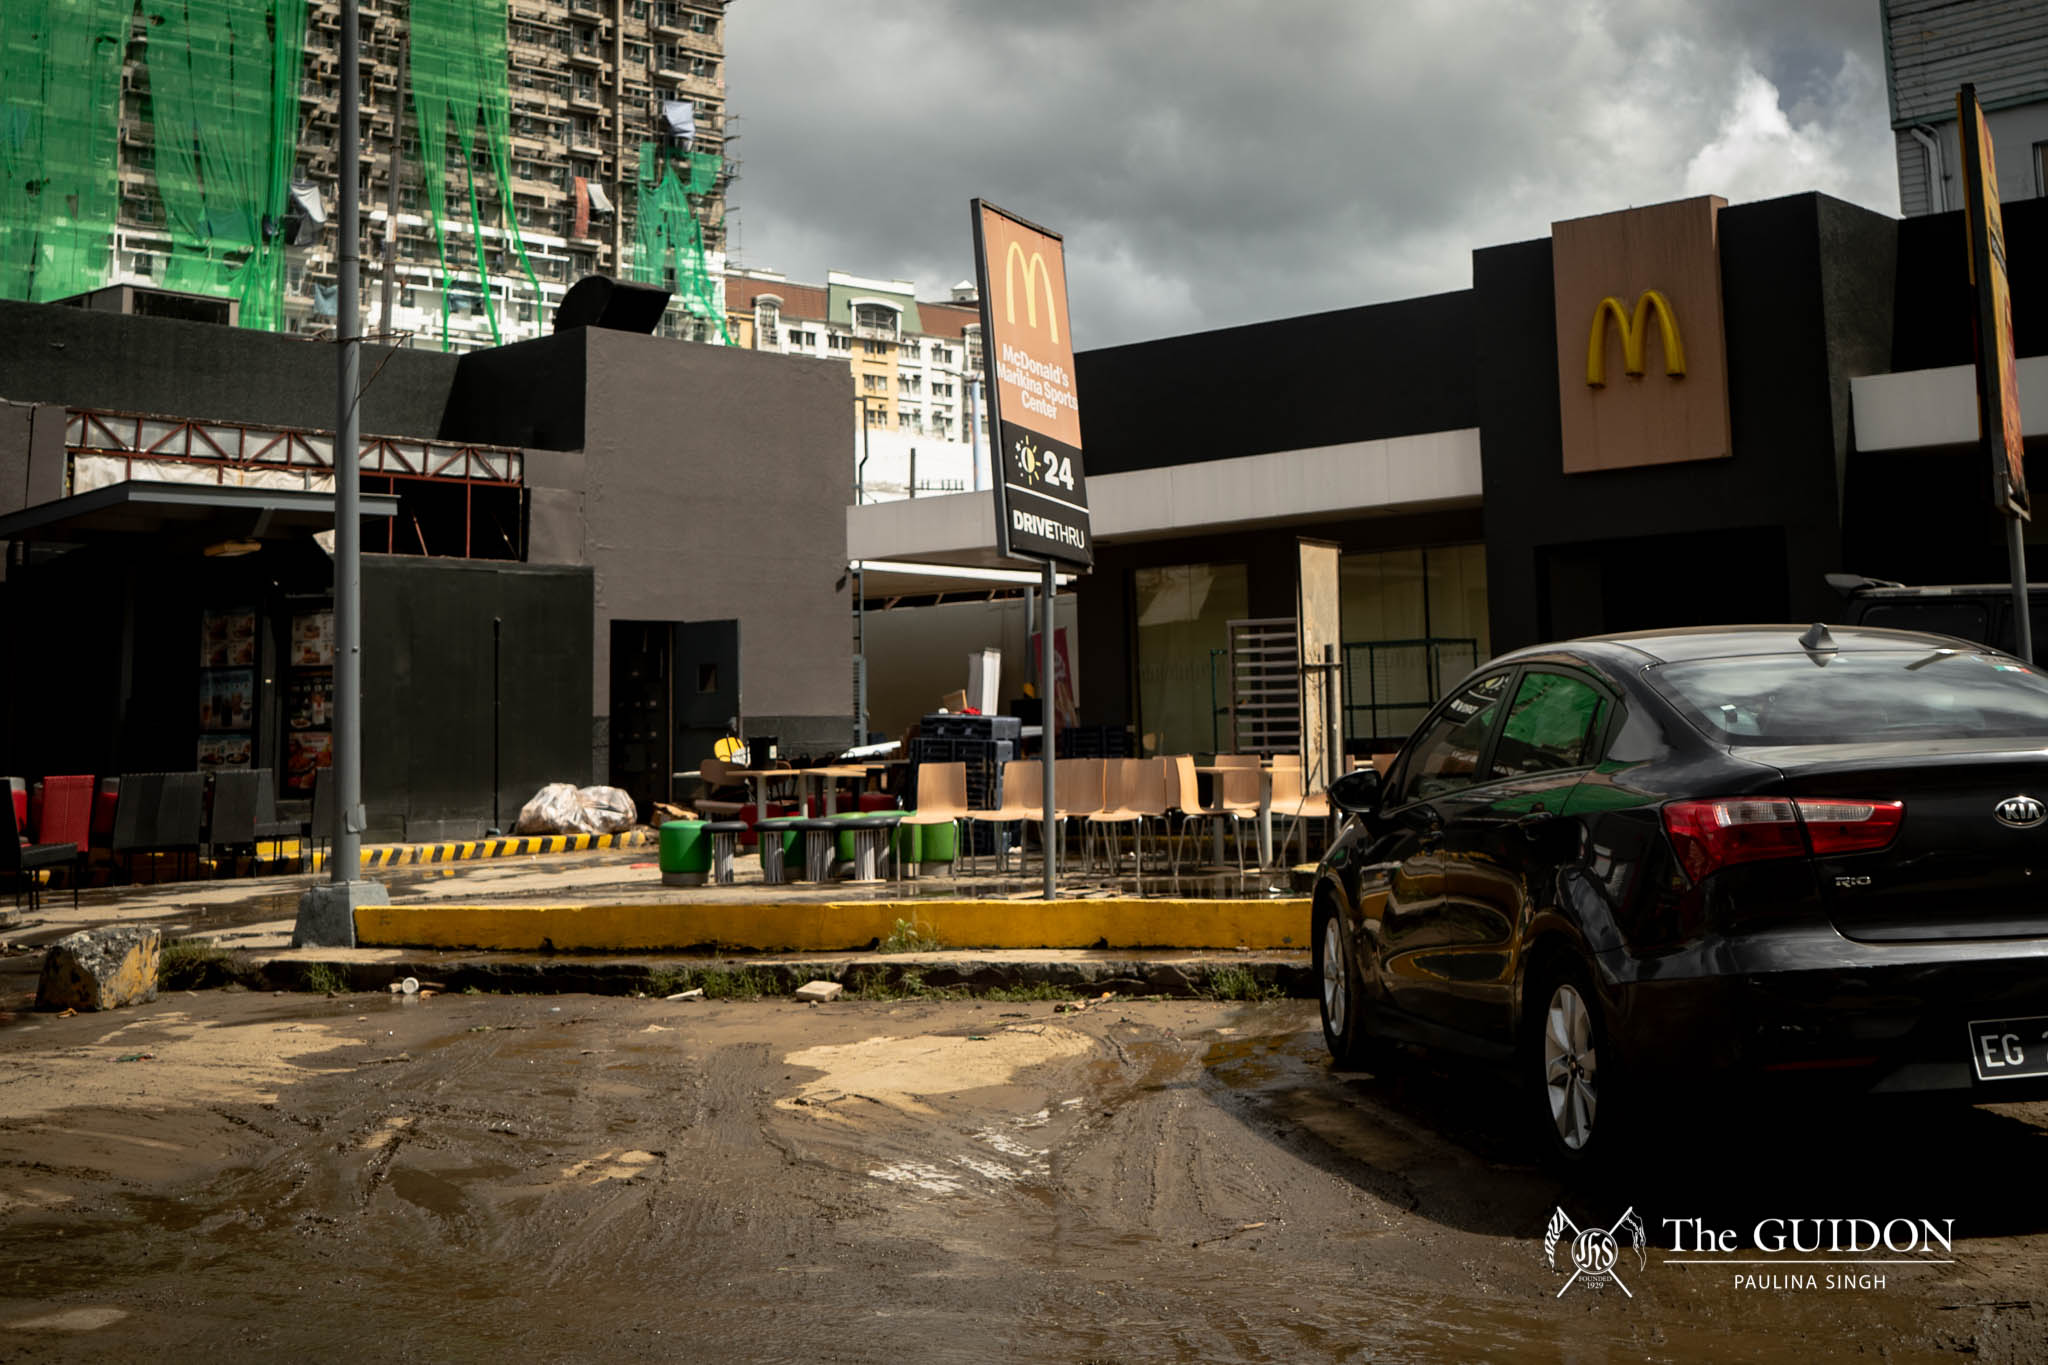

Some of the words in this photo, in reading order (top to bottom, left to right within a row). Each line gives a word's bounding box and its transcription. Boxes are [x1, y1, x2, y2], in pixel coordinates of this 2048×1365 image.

[1002, 343, 1070, 388] McDonald's
[997, 359, 1043, 395] Marikina
[1043, 381, 1079, 410] Sports
[1021, 390, 1057, 419] Center
[1043, 450, 1074, 491] 24
[2004, 802, 2040, 819] KIA
[1980, 1033, 2024, 1067] EG
